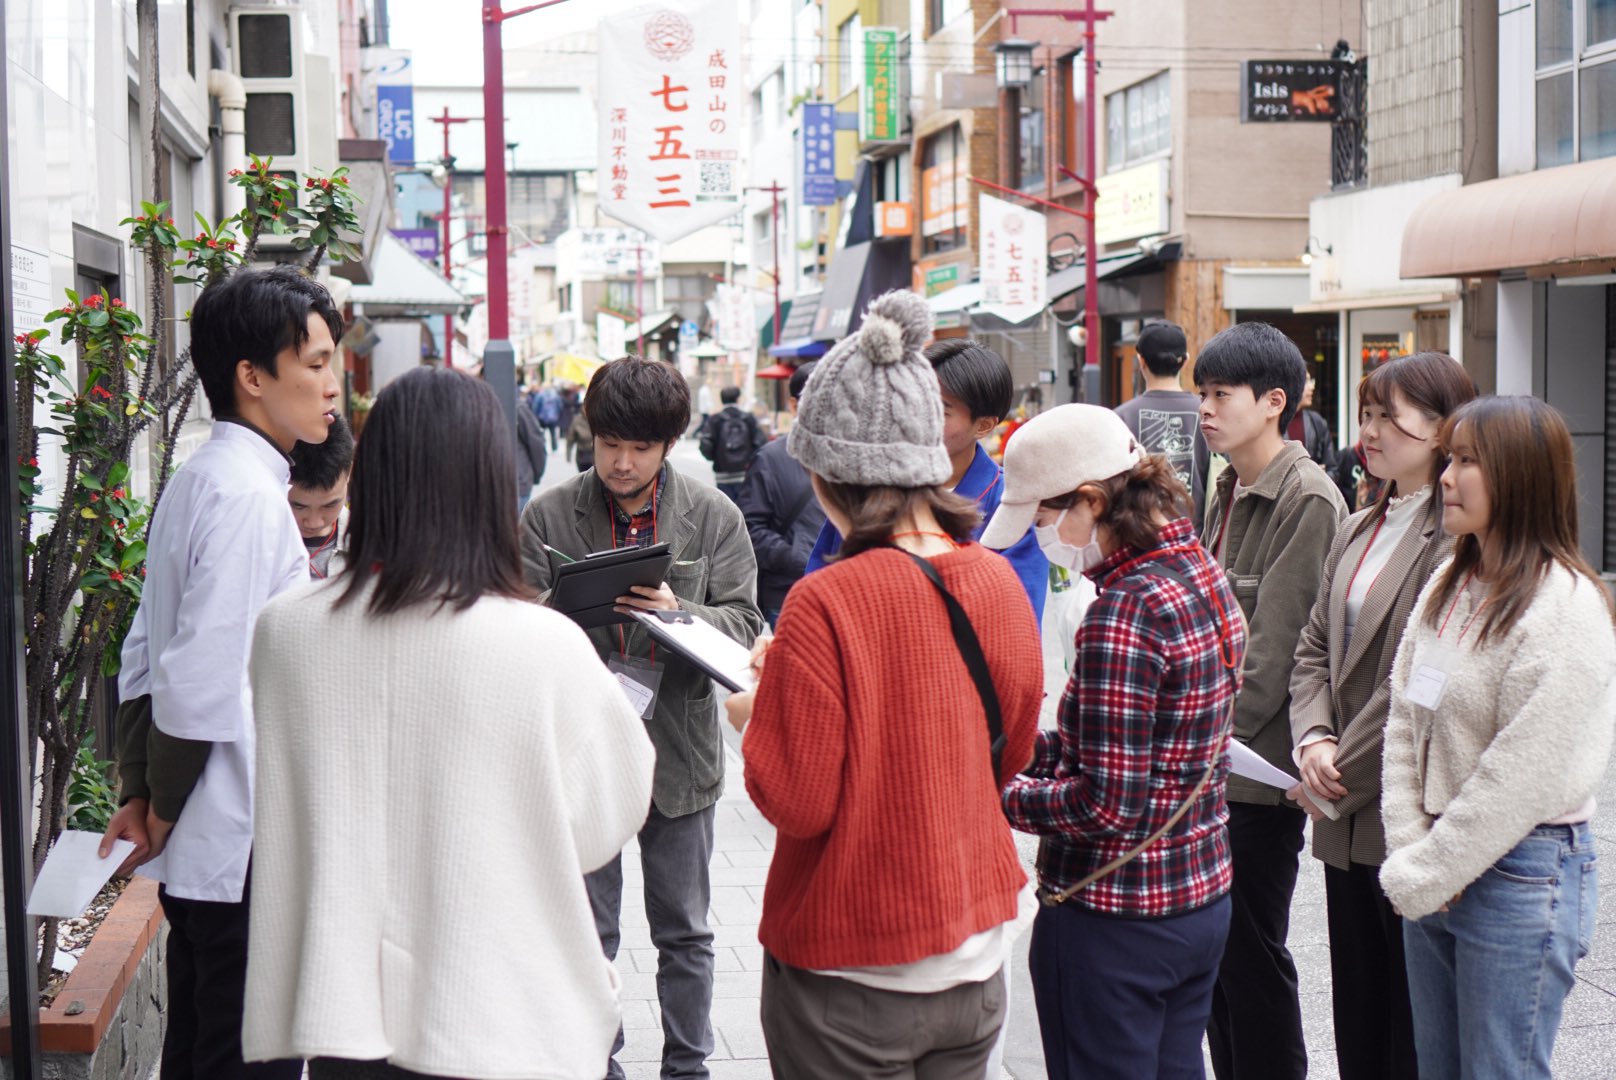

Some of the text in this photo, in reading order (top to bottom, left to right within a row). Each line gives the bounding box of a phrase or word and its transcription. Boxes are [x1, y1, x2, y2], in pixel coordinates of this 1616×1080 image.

[708, 49, 728, 135] 成田山の
[1253, 81, 1289, 98] Isis
[610, 107, 628, 201] 深川不動堂
[648, 74, 691, 208] 七五三
[1005, 242, 1024, 306] 七五三
